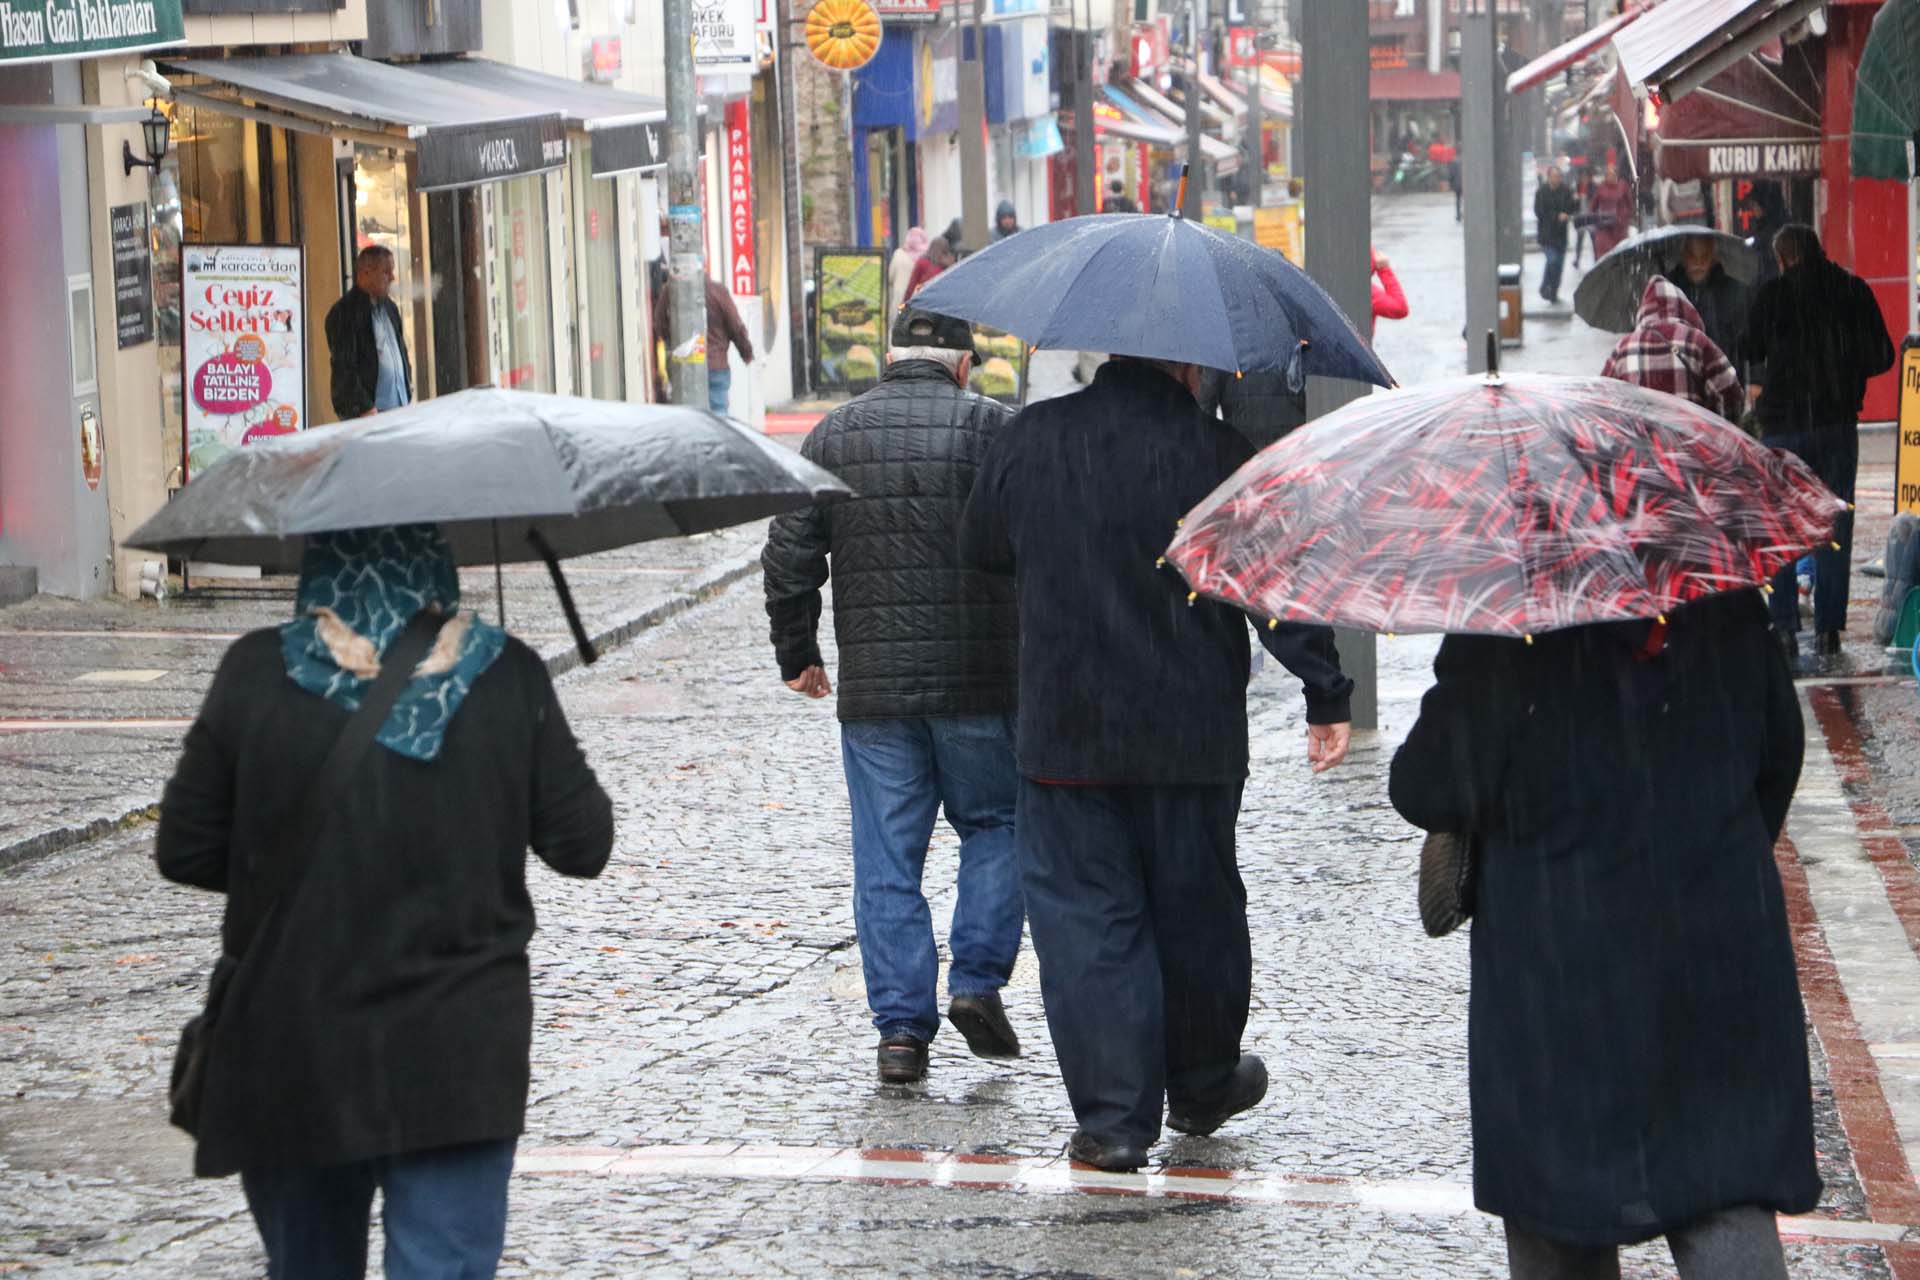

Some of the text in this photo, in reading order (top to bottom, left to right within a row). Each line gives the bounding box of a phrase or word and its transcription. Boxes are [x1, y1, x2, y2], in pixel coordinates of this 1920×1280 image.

[0, 0, 157, 47] Hasan Gazi Baklavaları
[485, 138, 519, 172] KARACA
[1709, 147, 1758, 173] KURU
[732, 129, 748, 247] PHARMACY
[205, 283, 275, 310] Çeyiz
[203, 374, 260, 387] TATİLİNİZ
[207, 363, 255, 375] BALAYI
[203, 387, 260, 401] BİZDEN
